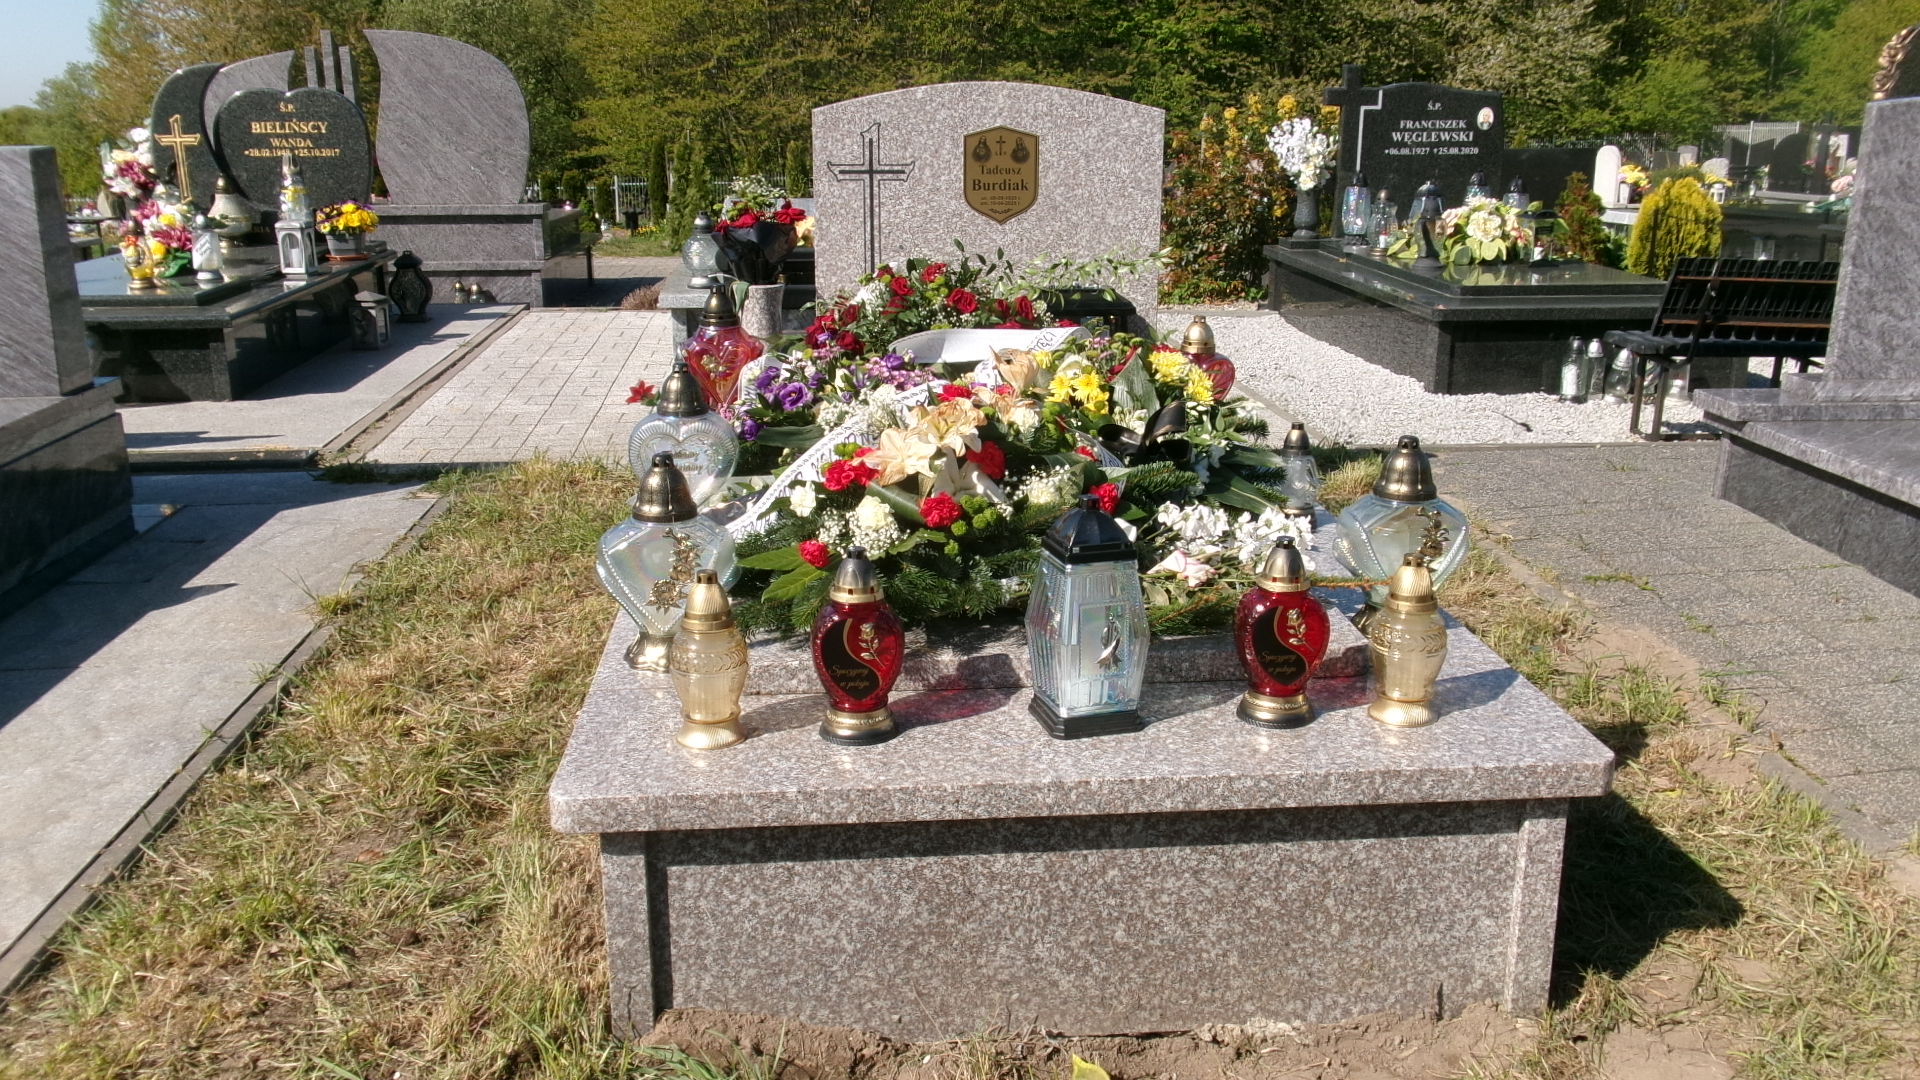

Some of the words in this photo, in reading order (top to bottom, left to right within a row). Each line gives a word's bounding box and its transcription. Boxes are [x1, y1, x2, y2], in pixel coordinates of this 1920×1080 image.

[251, 118, 328, 133] BIELIŃSCY
[1400, 119, 1467, 129] FRANCISZEK
[270, 138, 313, 147] WANDA
[1392, 131, 1474, 144] WĘGLEWSKI
[979, 164, 1022, 175] Tadeusz
[972, 178, 1029, 191] Burdiak
